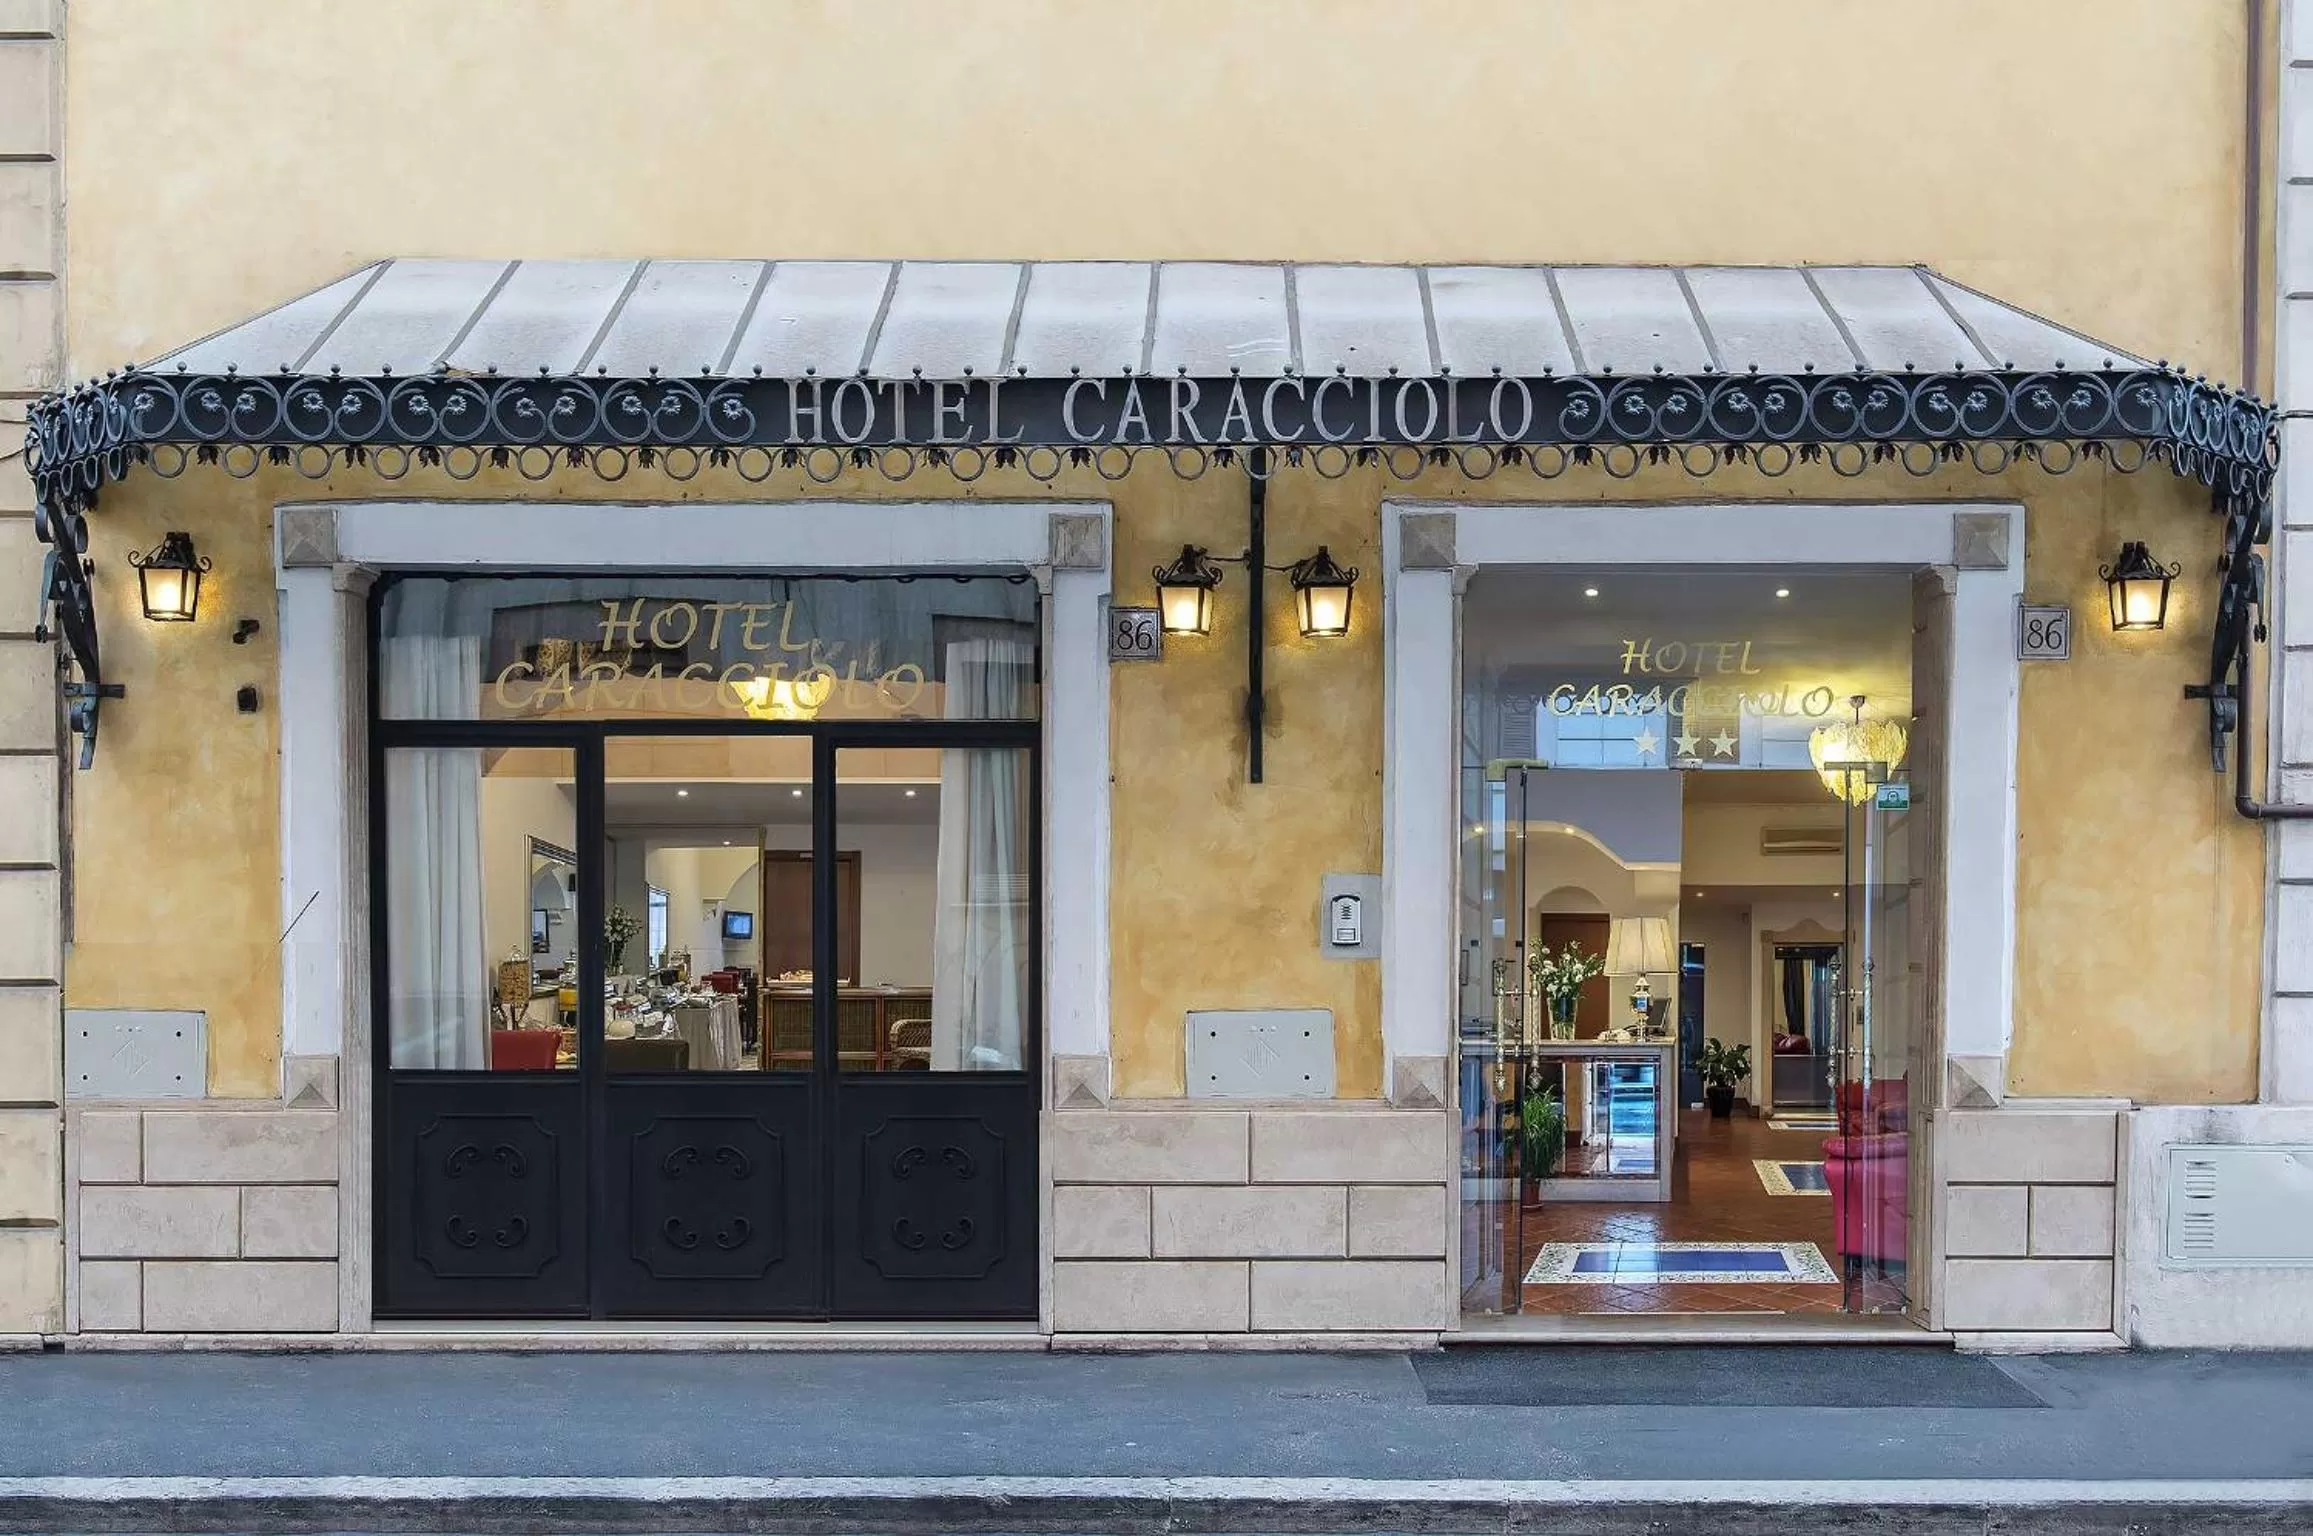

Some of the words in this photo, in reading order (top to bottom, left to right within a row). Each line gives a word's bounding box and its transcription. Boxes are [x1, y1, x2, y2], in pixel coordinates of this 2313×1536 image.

[783, 378, 1024, 444] HOTEL
[1062, 378, 1534, 444] CARACCIOLO
[600, 598, 807, 652] HOTEL
[1117, 619, 1153, 650] 86
[2027, 619, 2063, 650] 86
[1620, 639, 1760, 675] HOTEL
[495, 660, 925, 711] CARACCIOLO
[1549, 684, 1834, 718] CARACCOLO
